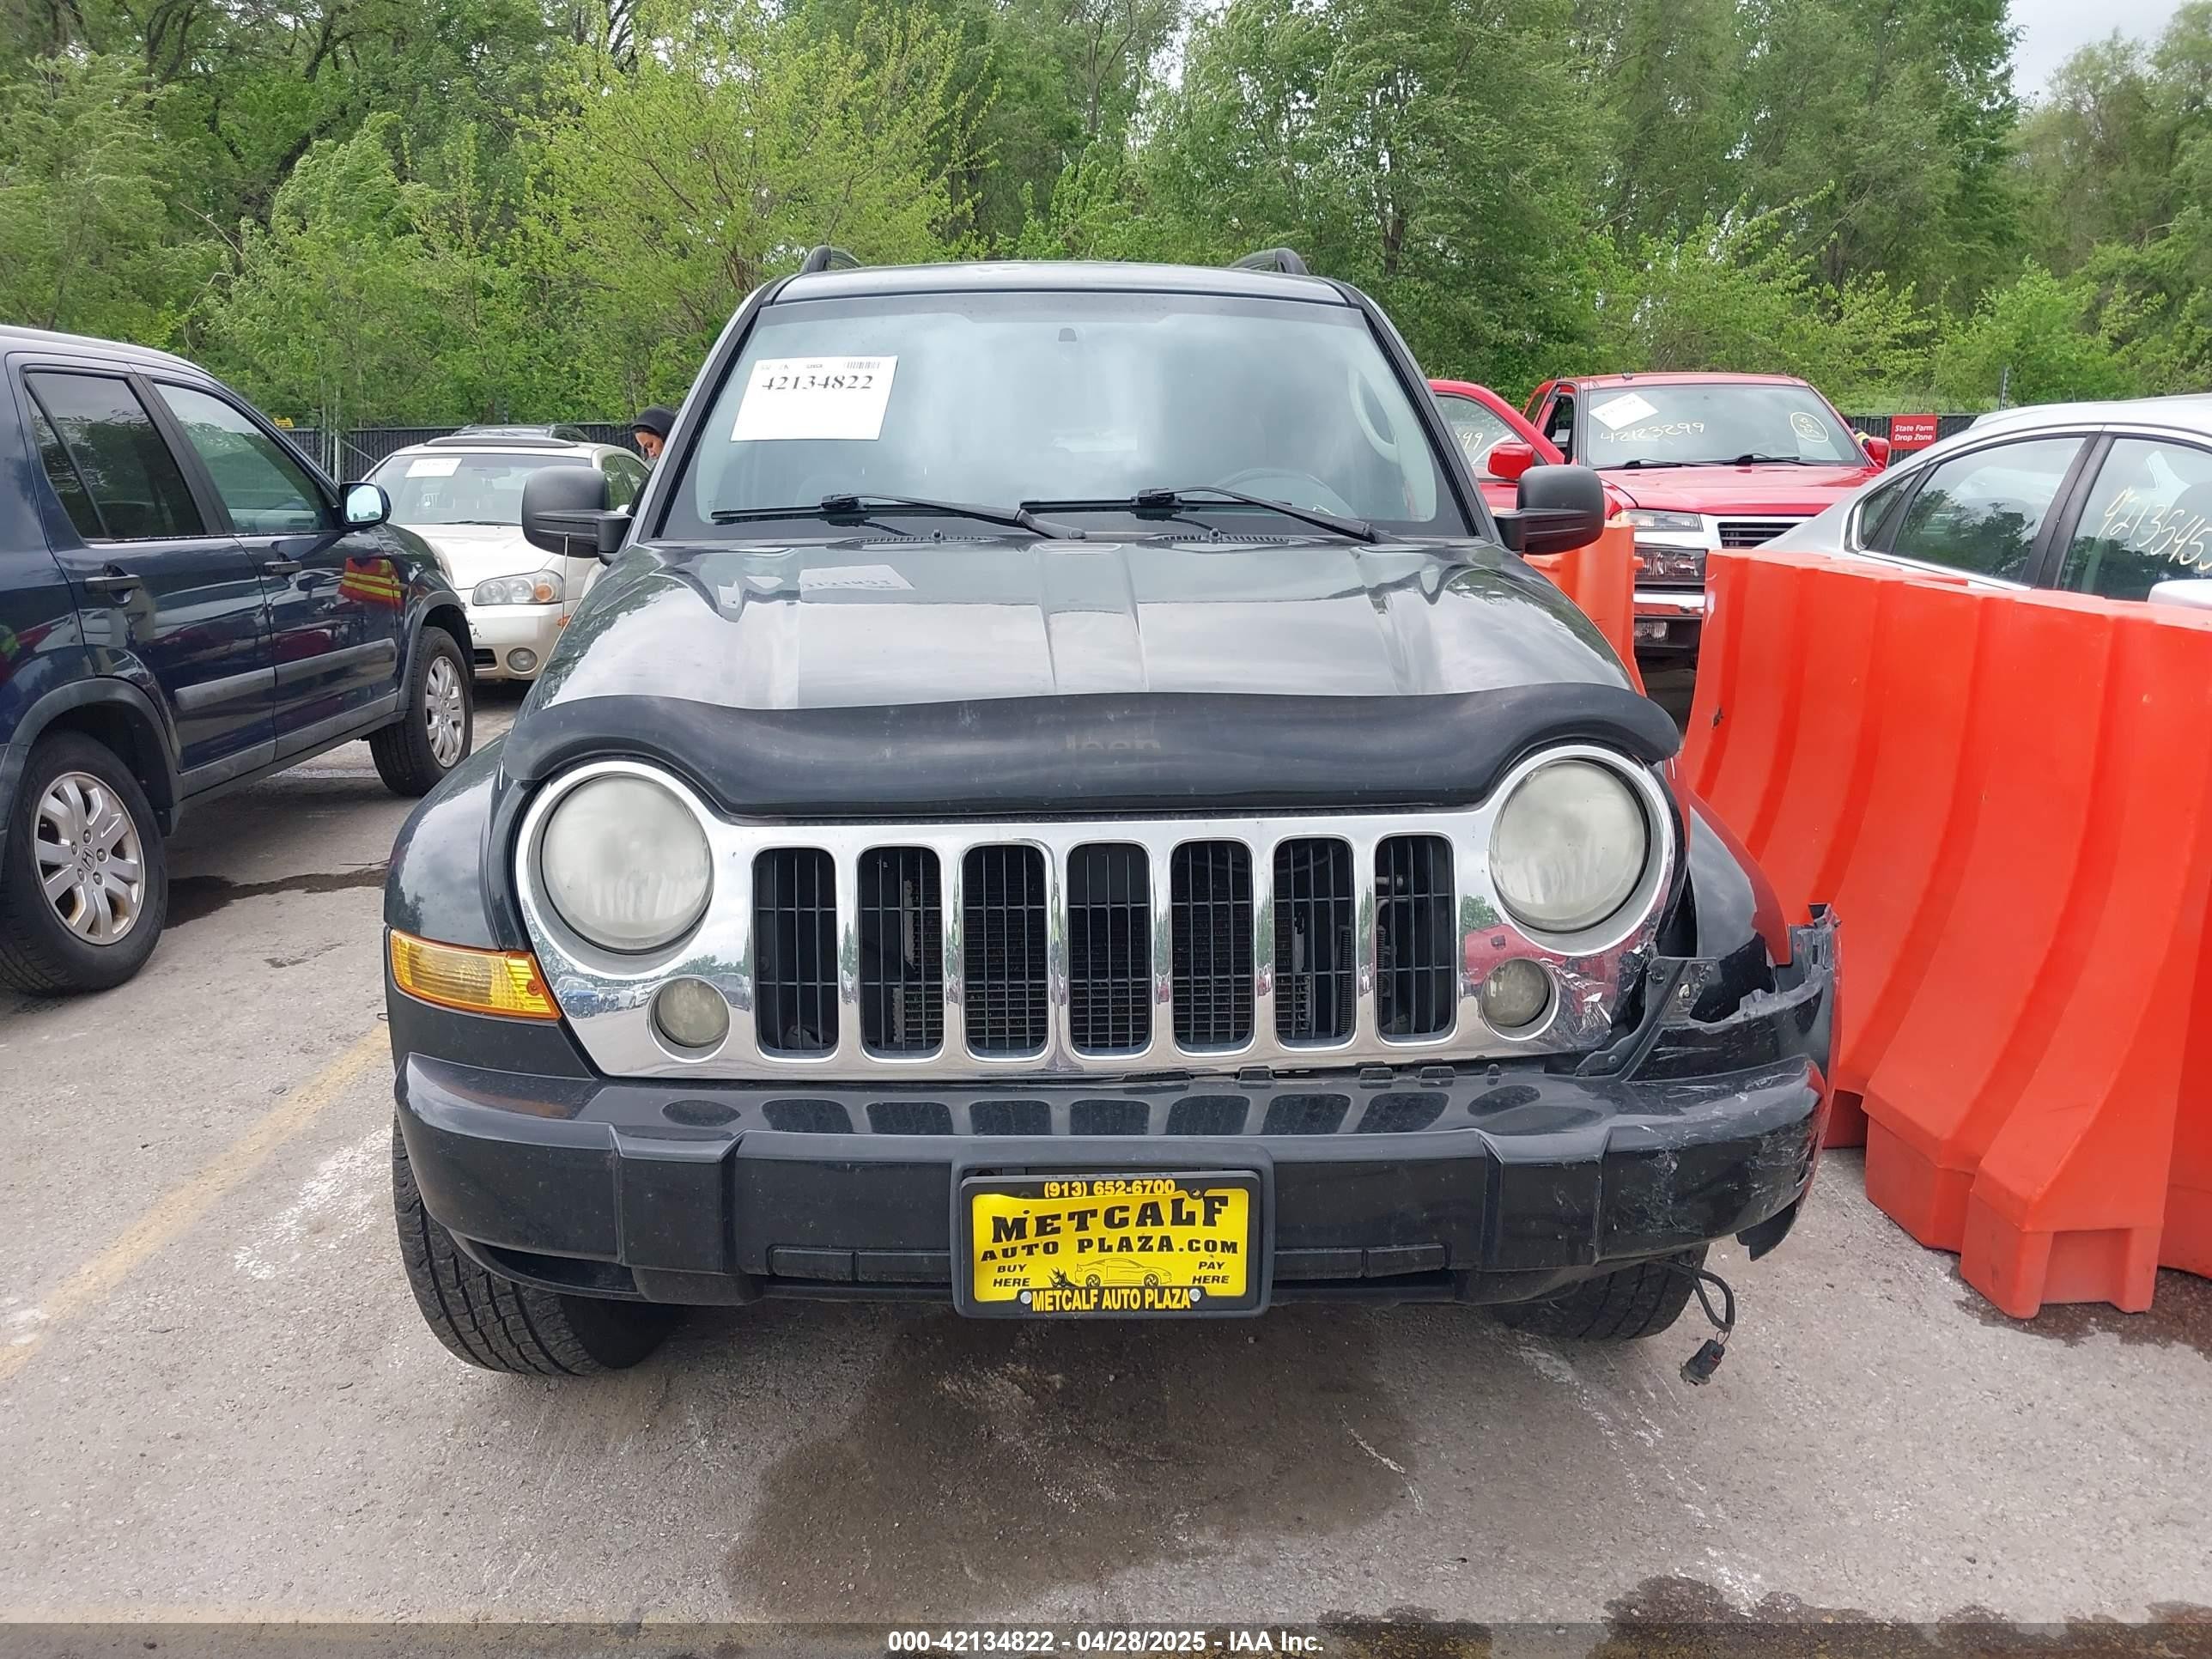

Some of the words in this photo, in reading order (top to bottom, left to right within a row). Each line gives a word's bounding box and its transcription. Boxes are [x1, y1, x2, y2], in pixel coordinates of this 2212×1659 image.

[762, 374, 874, 391] 42134822
[1600, 422, 1705, 443] 42123299
[1894, 434, 1913, 442] Drop
[1043, 1181, 1088, 1198] (913)
[1092, 1179, 1176, 1195] 652-6700
[991, 1195, 1229, 1243] METCALF
[981, 1241, 1060, 1261] AUTO
[1077, 1235, 1237, 1255] PLAZA.COM
[997, 1264, 1027, 1273] BUY
[1198, 1261, 1225, 1271] PAY
[993, 1277, 1030, 1287] HERE
[1192, 1274, 1230, 1285] HERE
[1031, 1290, 1099, 1312] METCALF
[1101, 1289, 1141, 1310] AUTO
[1145, 1288, 1192, 1310] PLAZA
